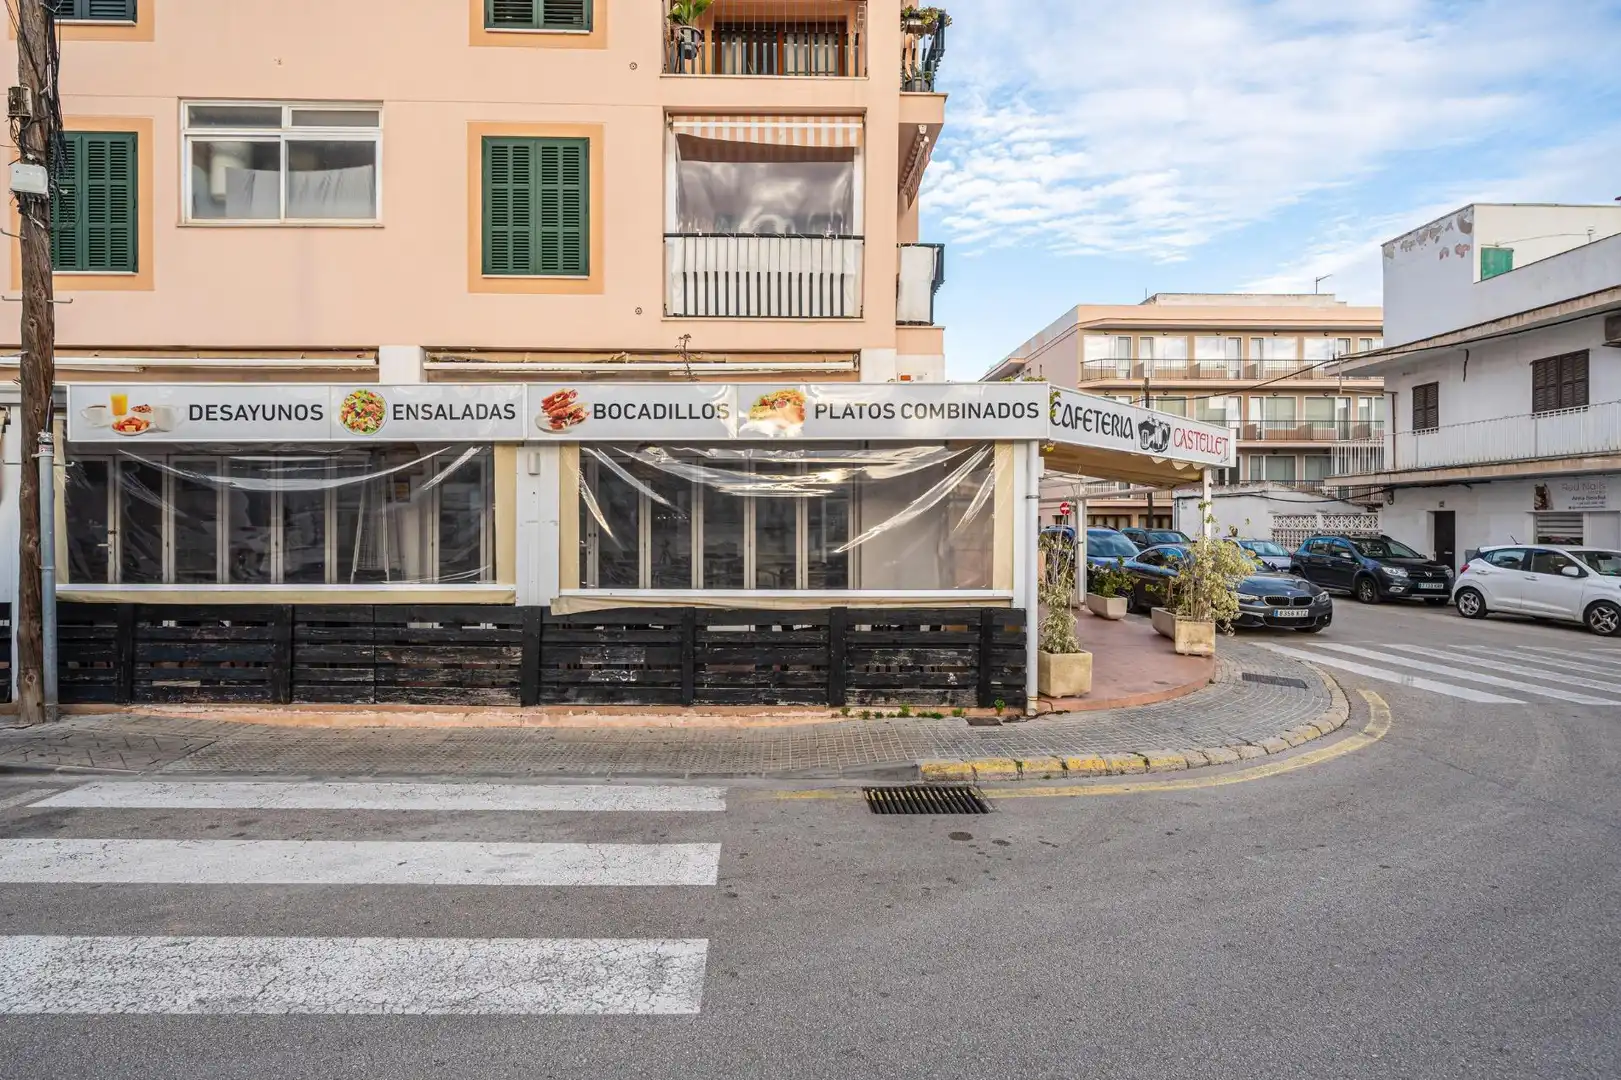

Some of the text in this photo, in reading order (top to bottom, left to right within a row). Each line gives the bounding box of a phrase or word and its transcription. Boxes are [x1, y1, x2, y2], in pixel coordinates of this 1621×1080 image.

[189, 403, 324, 422] DESAYUNOS
[392, 402, 516, 421] ENSALADAS
[593, 402, 730, 420] BOCADILLOS
[814, 401, 1040, 420] PLATOS COMBINADOS
[1050, 401, 1229, 460] CAFETERIA CASTELLET
